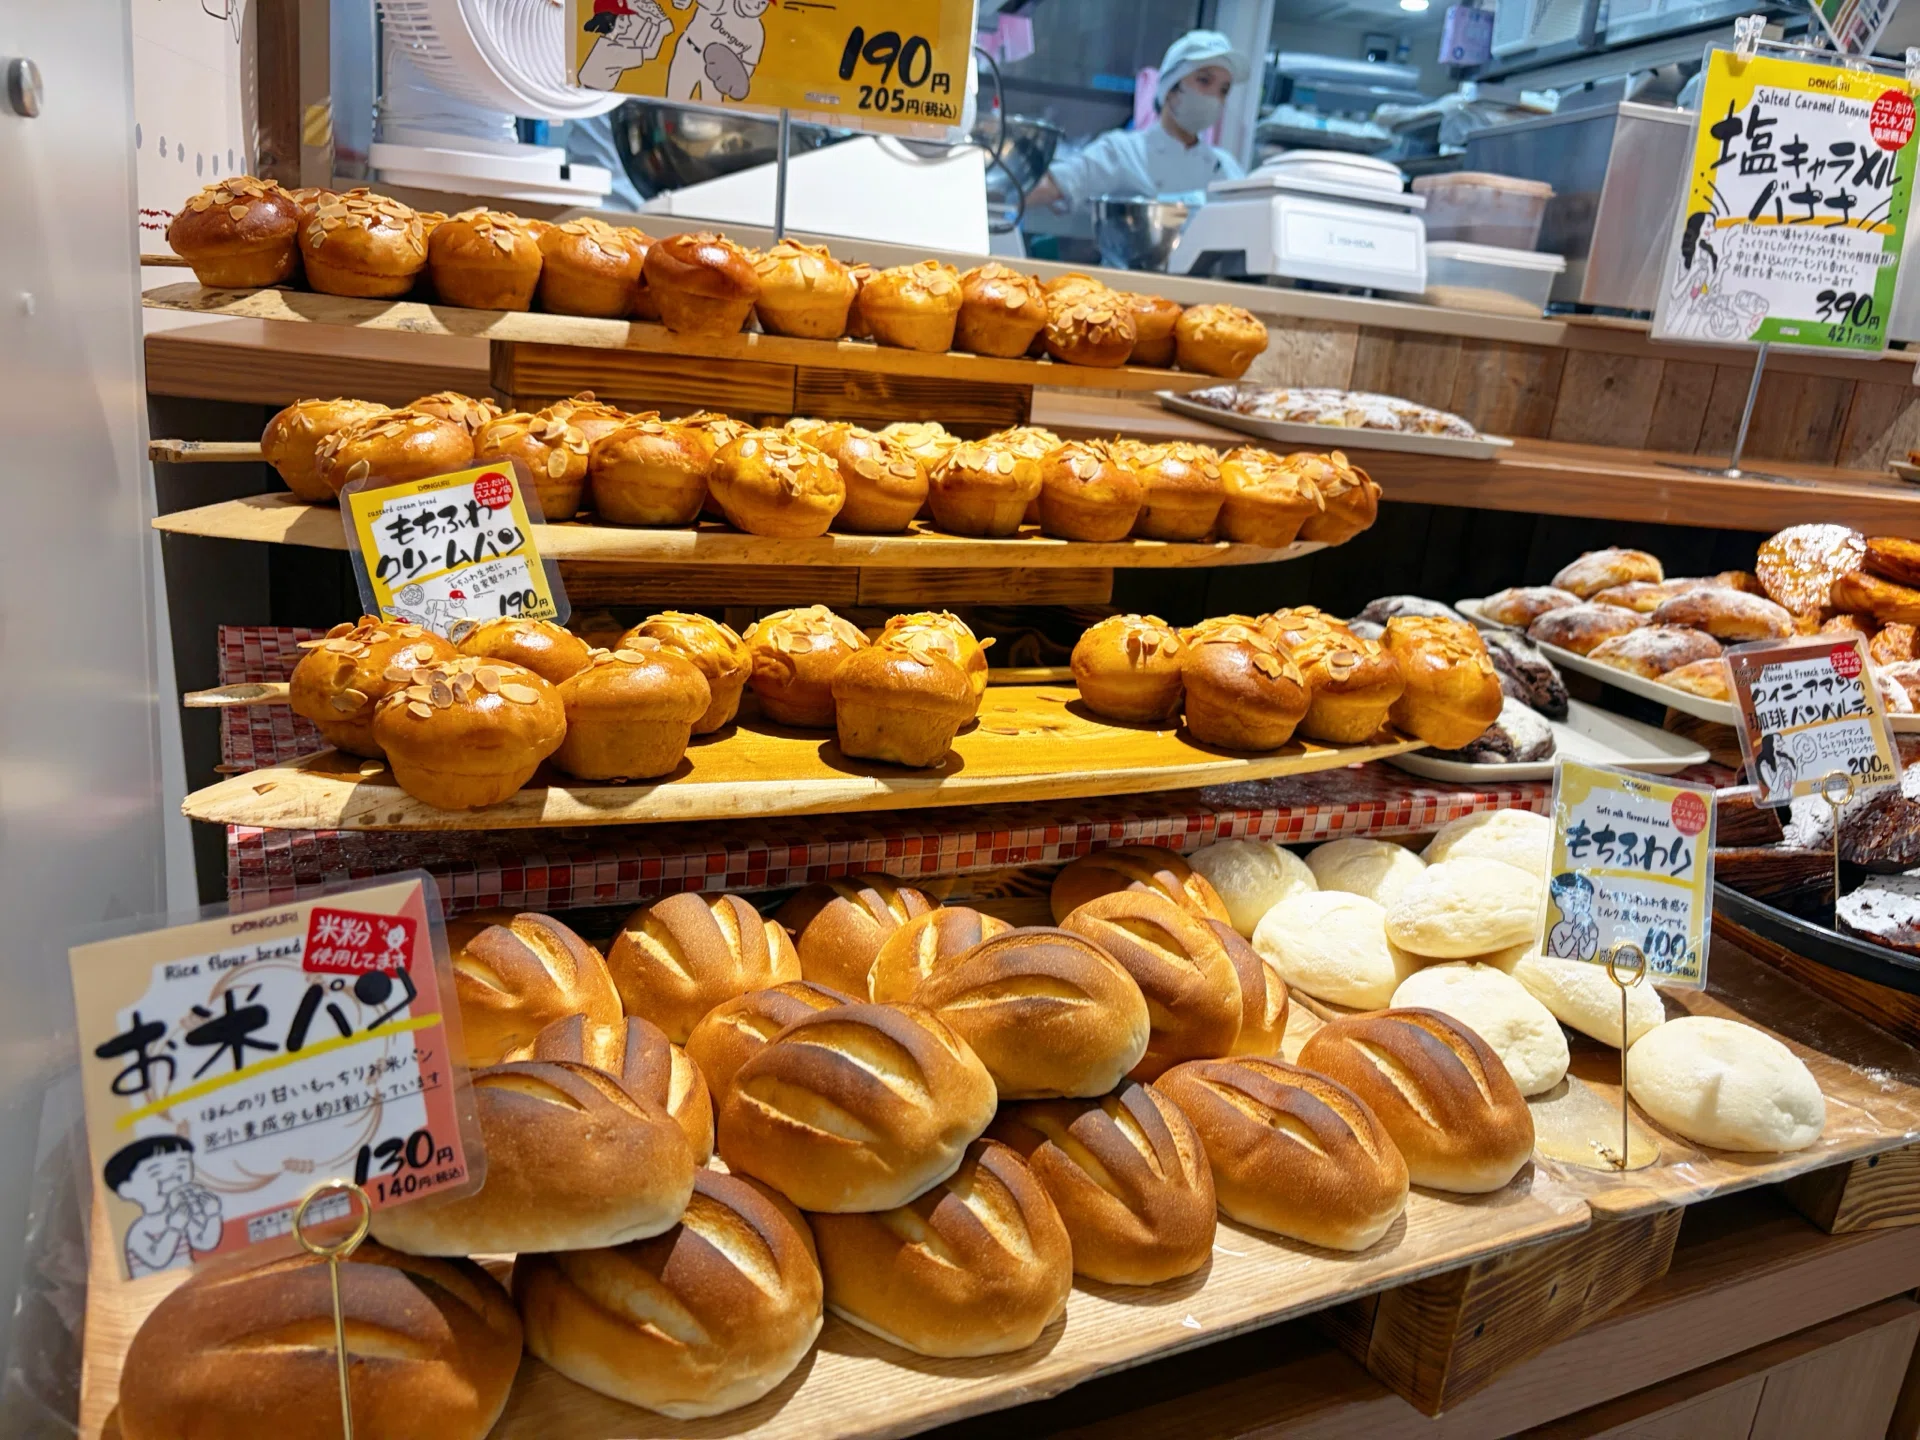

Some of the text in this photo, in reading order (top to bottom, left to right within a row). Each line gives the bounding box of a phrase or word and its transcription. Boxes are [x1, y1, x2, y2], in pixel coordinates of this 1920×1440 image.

[838, 26, 951, 95] 190円
[858, 86, 958, 119] 205円(税込)
[1758, 90, 1869, 118] Salted Caramel Banana
[1710, 98, 1902, 189] 塩キャラメル
[1748, 180, 1857, 228] バナナ
[1816, 289, 1880, 331] 390円
[417, 480, 451, 492] DONGURI
[367, 496, 437, 518] custard cream bread
[385, 500, 492, 545] もちふわ
[376, 526, 525, 585] クリームパン
[500, 589, 548, 616] 190円
[1795, 668, 1819, 678] French
[1847, 754, 1890, 776] 200円
[1596, 805, 1669, 828] Soft milk flavored bread
[1566, 819, 1692, 877] もちふわり
[231, 912, 299, 935] DONGURI
[312, 914, 372, 947] 米粉
[165, 938, 301, 981] Rice flour bread
[310, 946, 407, 971] 使用してます
[95, 966, 418, 1095] お米パン
[355, 1129, 454, 1186] 130円
[377, 1166, 464, 1203] 140円(税込)
